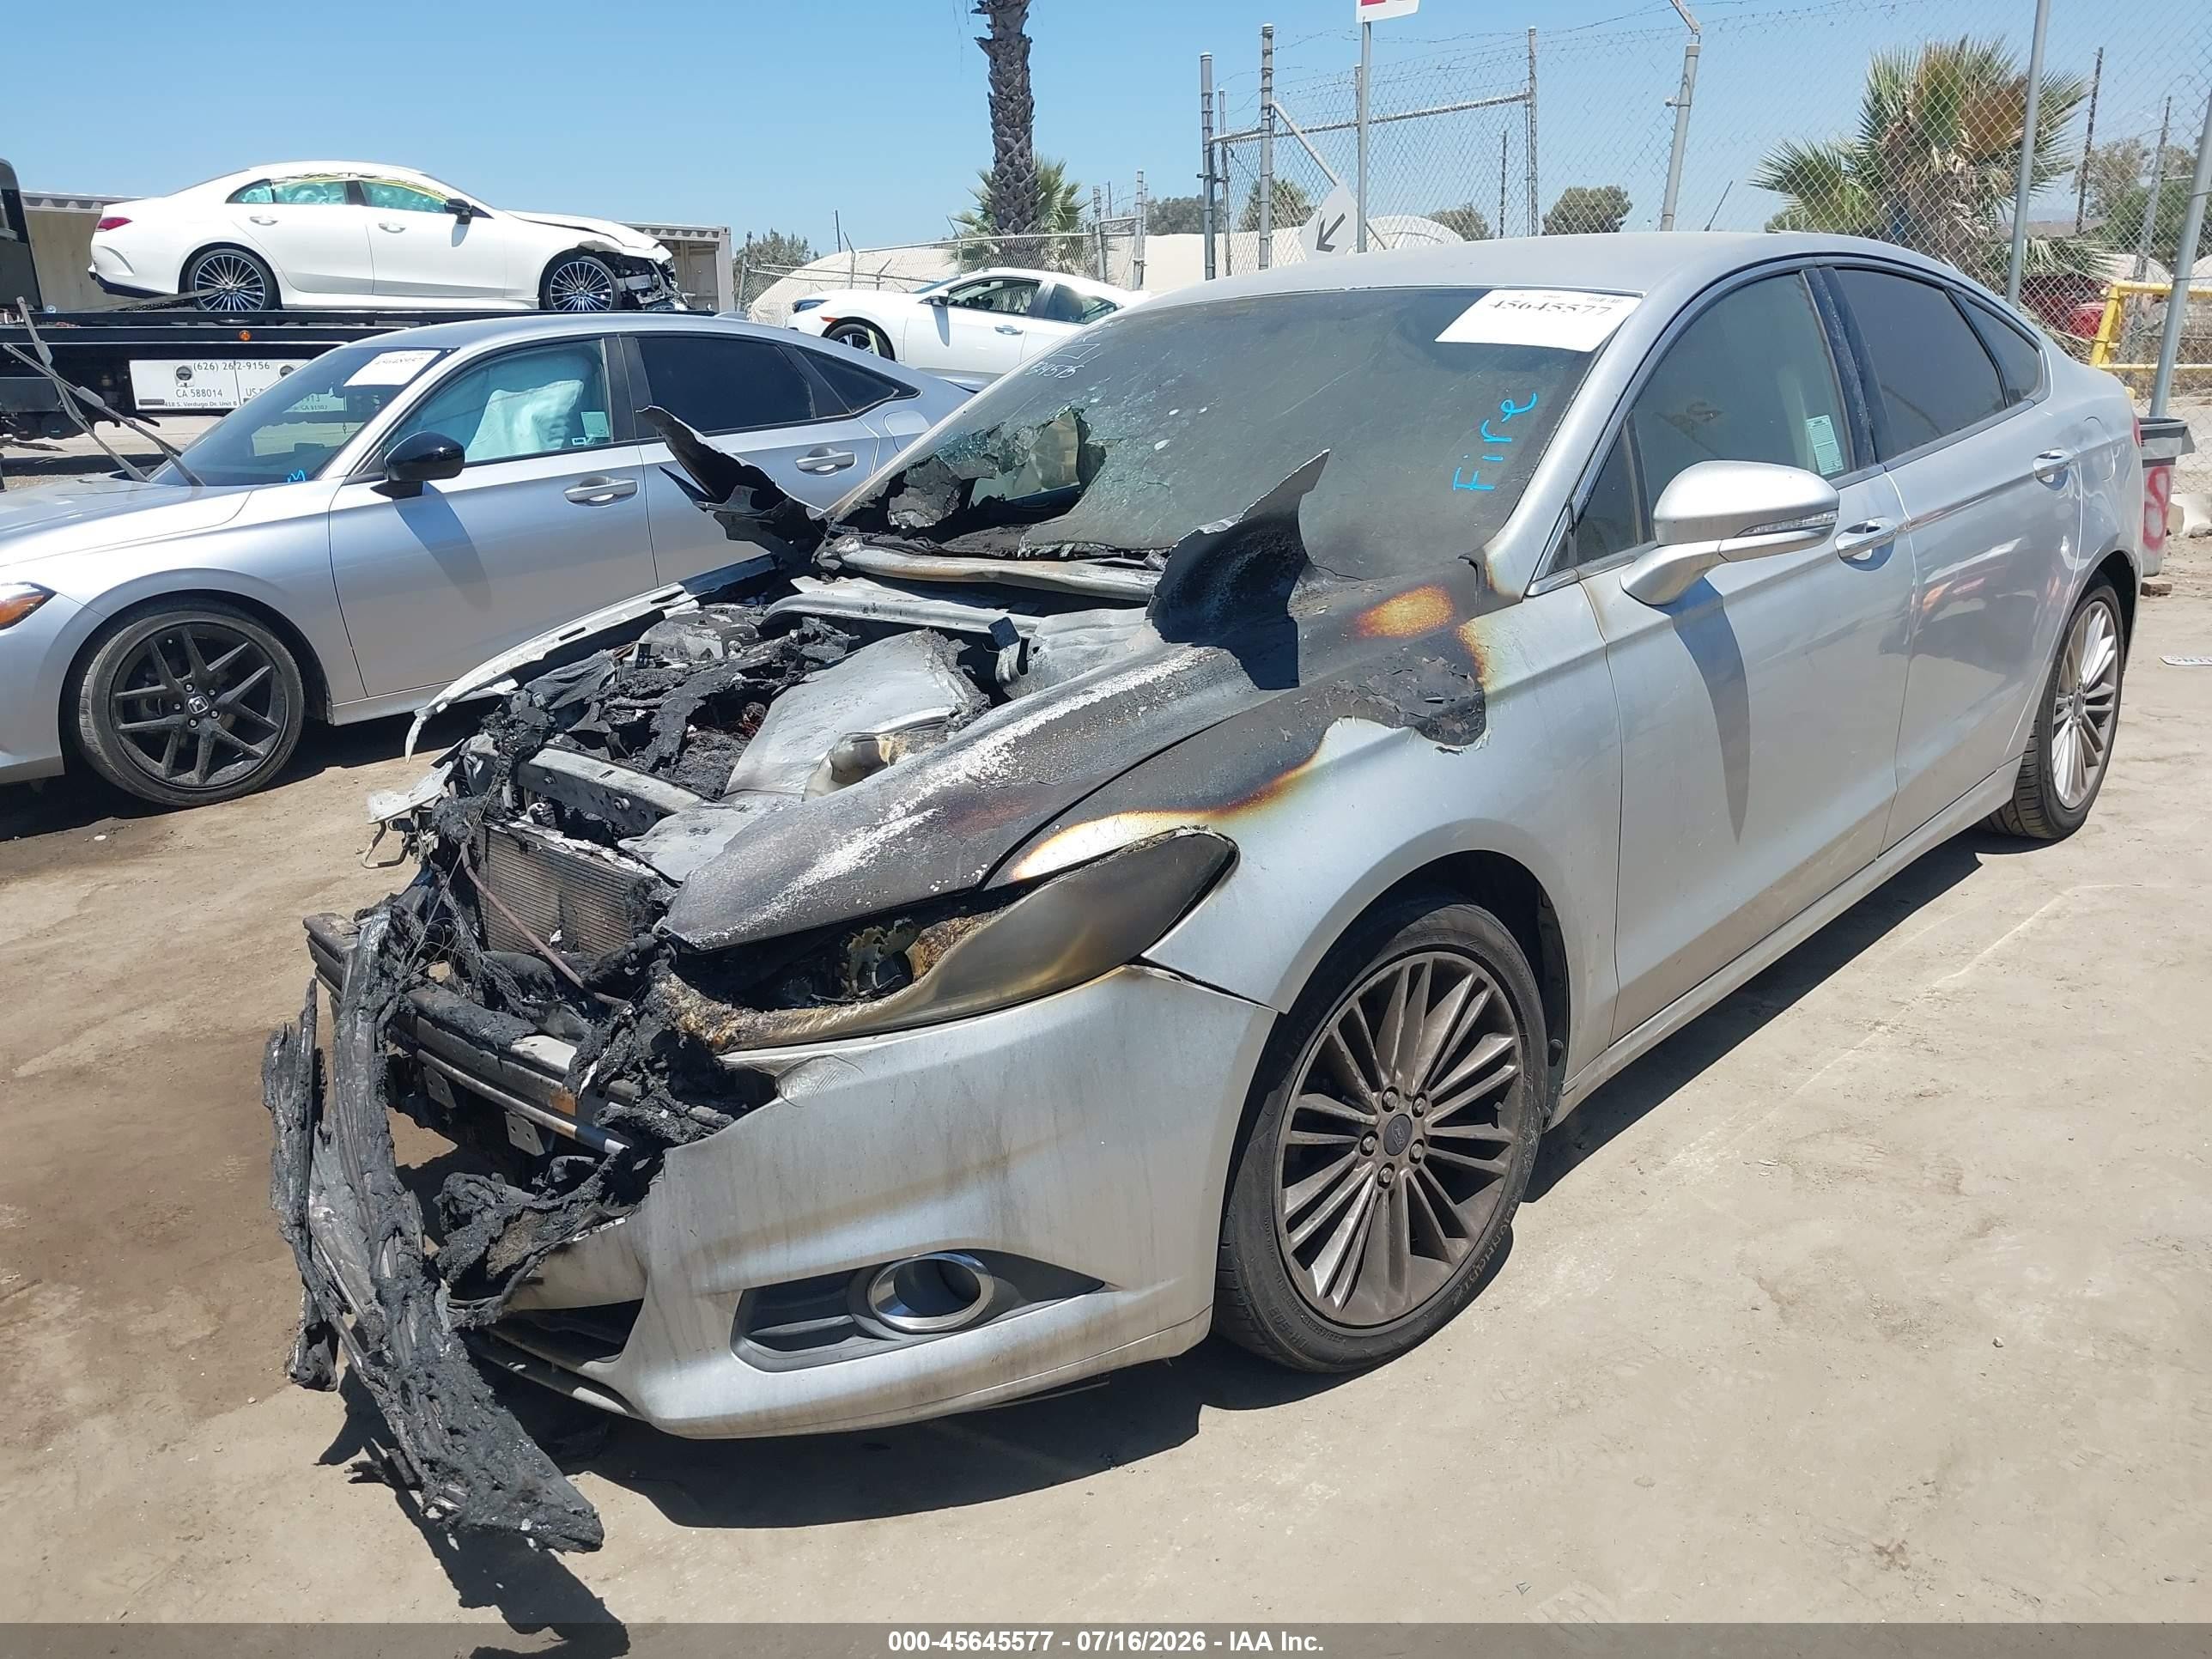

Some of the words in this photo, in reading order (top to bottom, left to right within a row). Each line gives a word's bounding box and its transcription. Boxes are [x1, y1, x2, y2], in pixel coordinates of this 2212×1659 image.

[193, 362, 219, 372] (626)
[222, 362, 270, 371] 262-9156
[175, 389, 188, 398] CA
[191, 389, 223, 398] 588014
[1452, 392, 1538, 491] Fire
